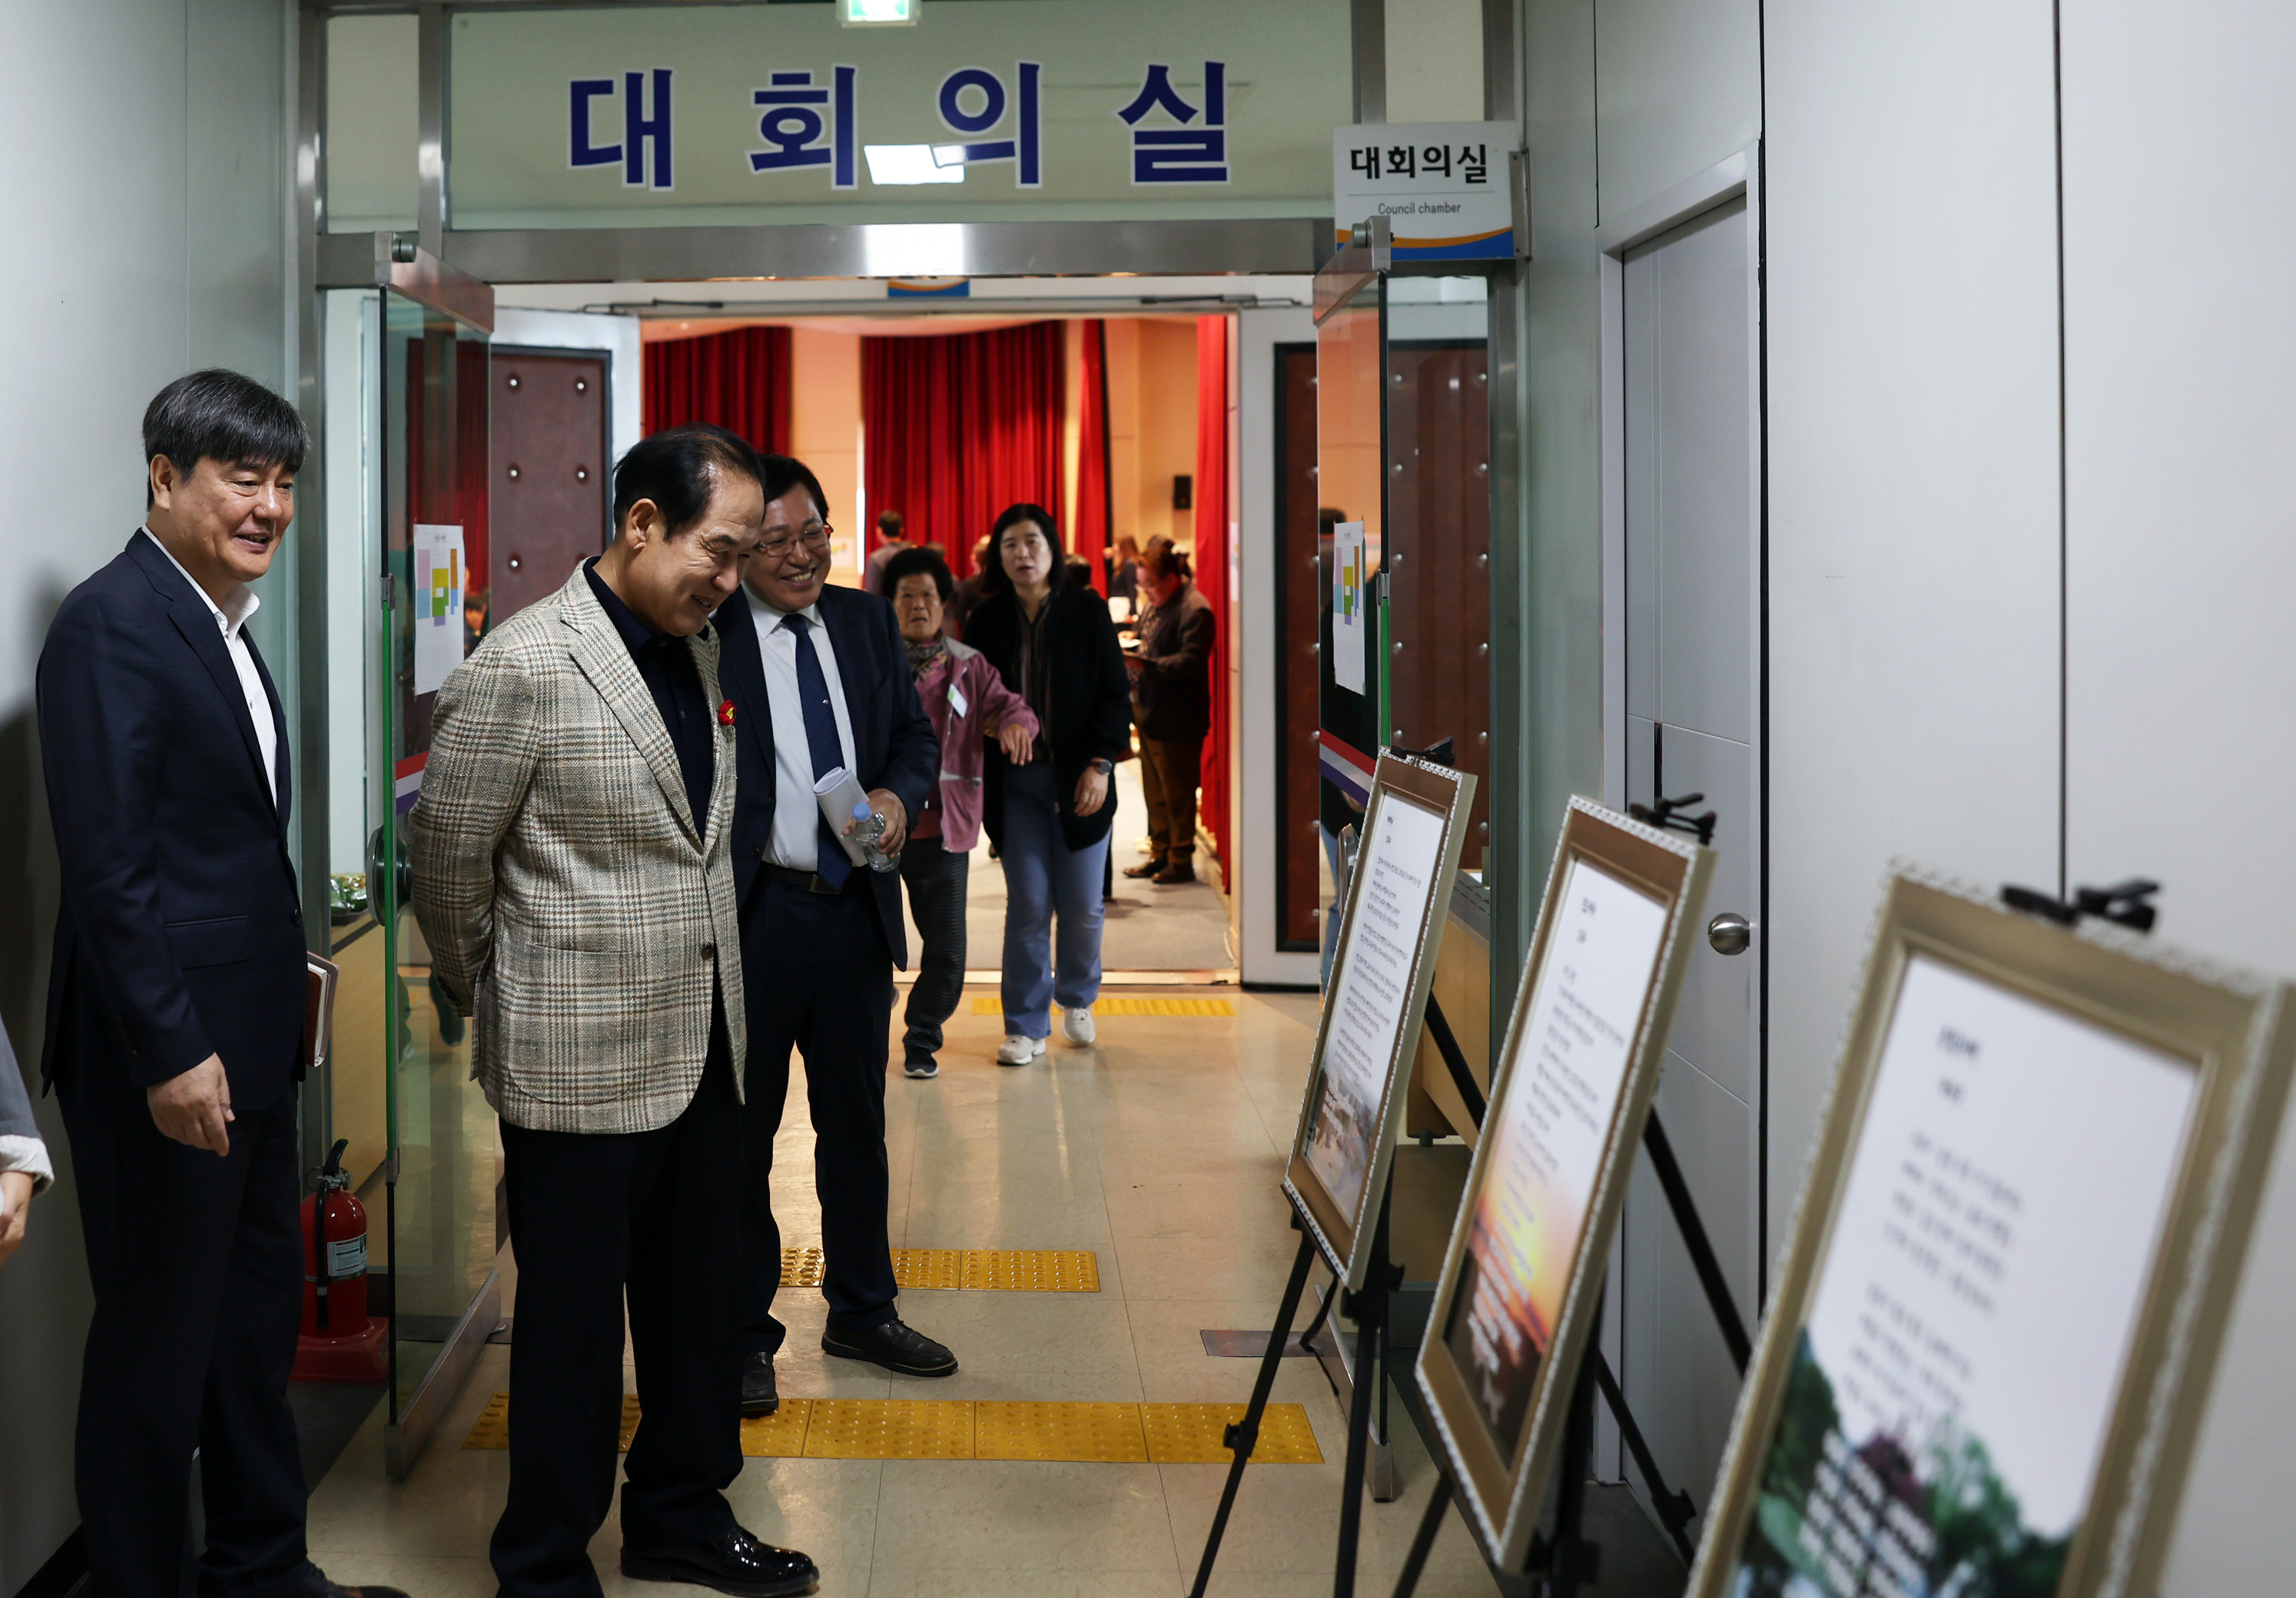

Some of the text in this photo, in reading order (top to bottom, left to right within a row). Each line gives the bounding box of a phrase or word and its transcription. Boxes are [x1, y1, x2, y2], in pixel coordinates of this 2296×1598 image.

[569, 61, 1229, 191] 대회의실
[1350, 144, 1488, 184] 대회의실
[1379, 202, 1462, 215] Council chamber
